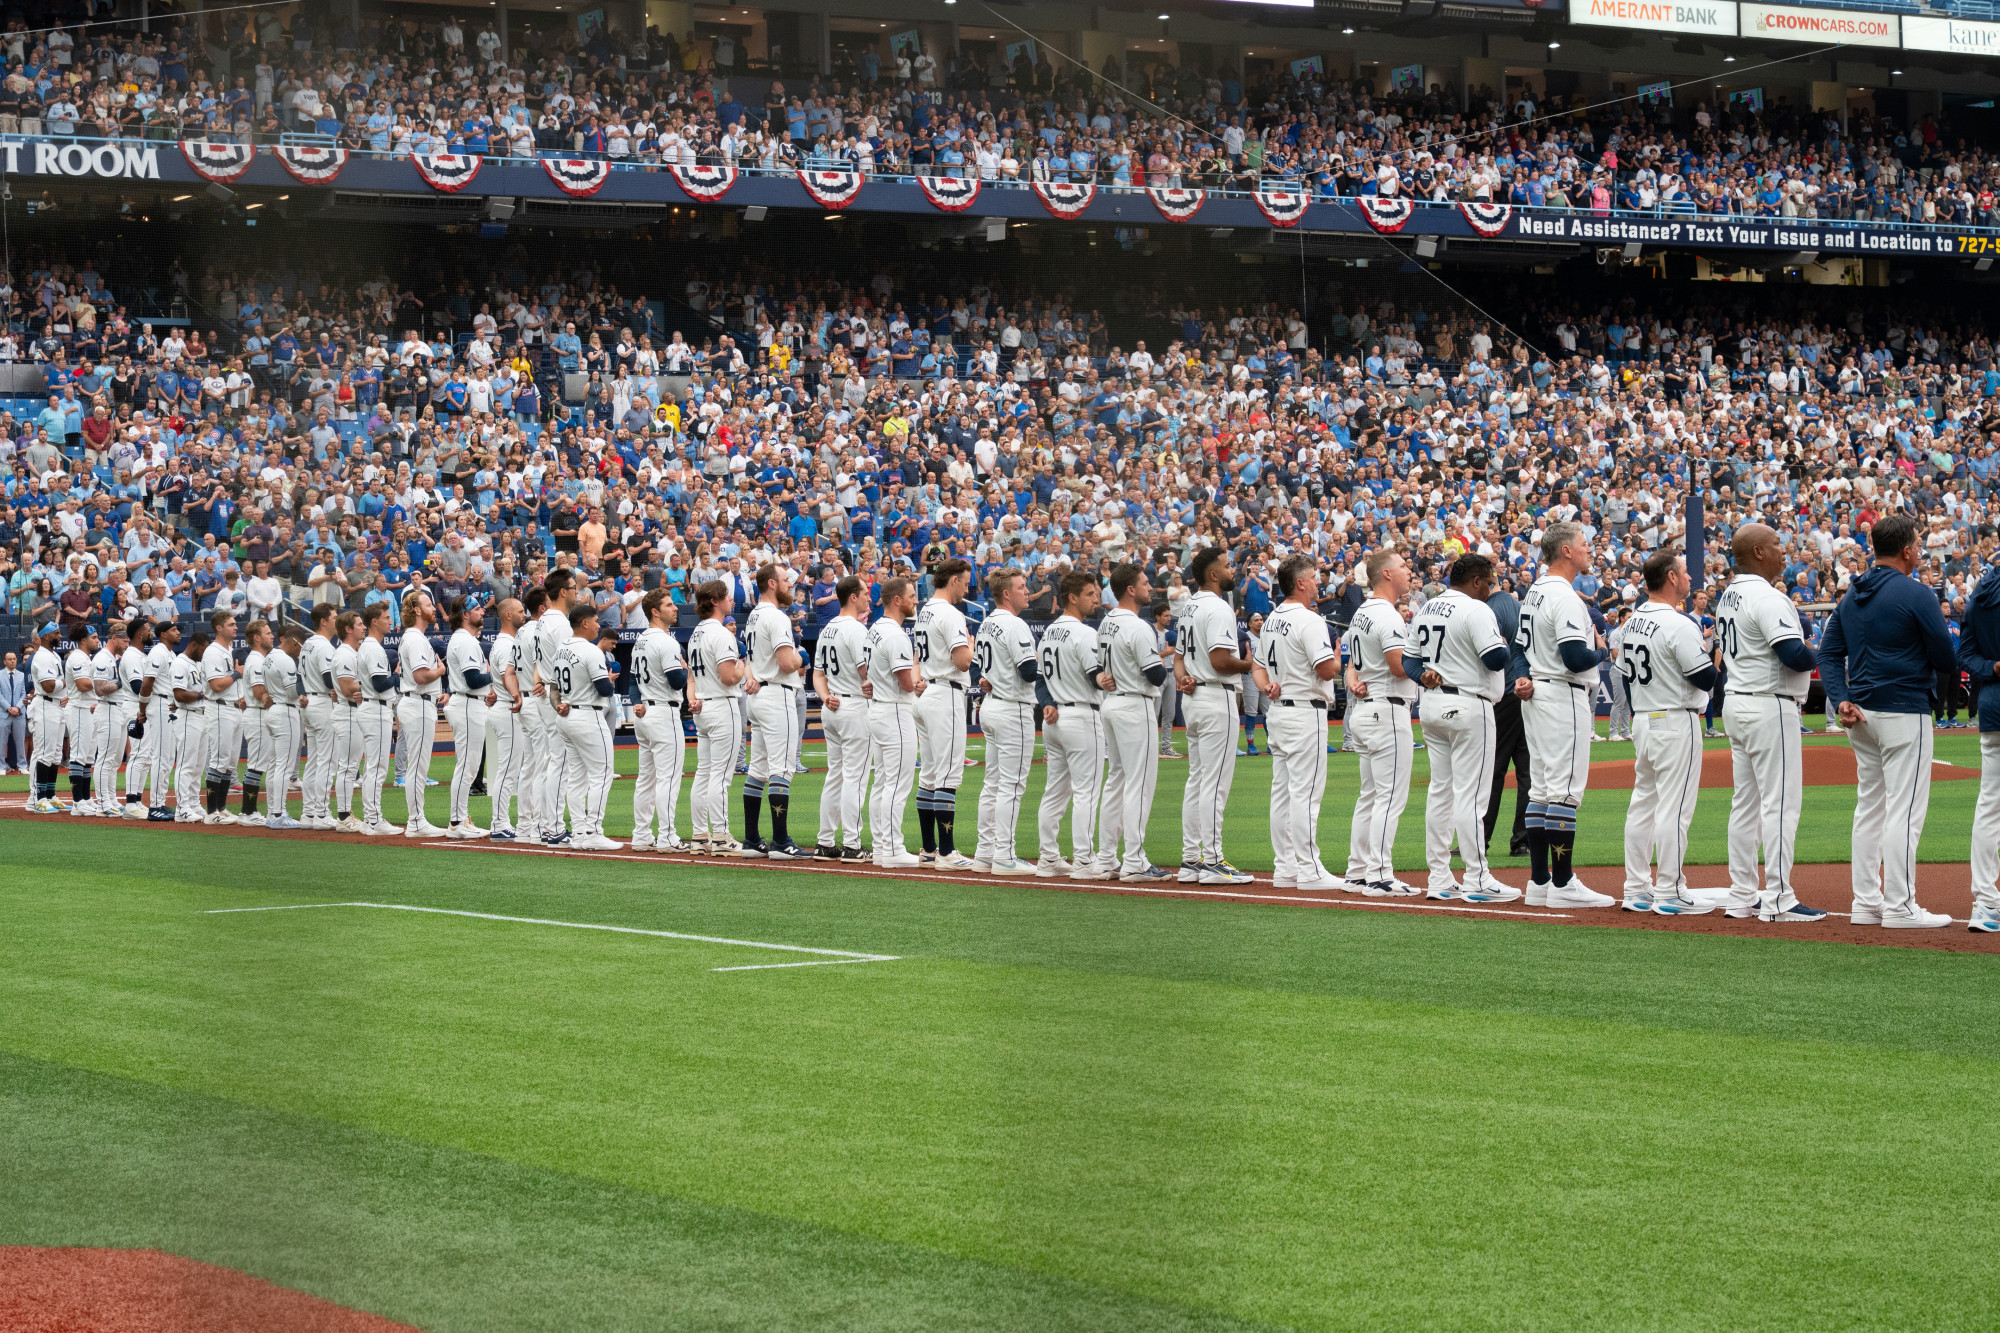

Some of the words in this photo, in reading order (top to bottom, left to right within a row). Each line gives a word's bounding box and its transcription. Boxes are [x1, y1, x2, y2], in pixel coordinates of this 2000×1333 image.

[1591, 0, 1672, 21] AMERANT
[1676, 7, 1717, 25] BANK
[1766, 14, 1888, 36] CROWNCARS.COM
[35, 143, 160, 178] ROOM
[1519, 217, 1565, 235] Need
[1571, 219, 1681, 240] Assistance?
[1686, 224, 1723, 242] Text
[1729, 226, 1768, 244] Your
[1774, 229, 1819, 247] Issue
[1825, 232, 1854, 248] and
[1861, 232, 1931, 251] Location
[1937, 236, 1952, 252] to
[1419, 601, 1455, 618] INARES
[1262, 618, 1291, 636] ILLIAMS
[1520, 614, 1536, 653] 51
[1719, 617, 1738, 659] 30
[1268, 640, 1278, 675] 4
[1418, 625, 1445, 663] 27
[635, 656, 650, 684] 43
[691, 648, 705, 677] 44
[822, 645, 840, 676] 49
[1043, 647, 1061, 680] 61
[1623, 643, 1652, 685] 53
[554, 666, 571, 694] 39
